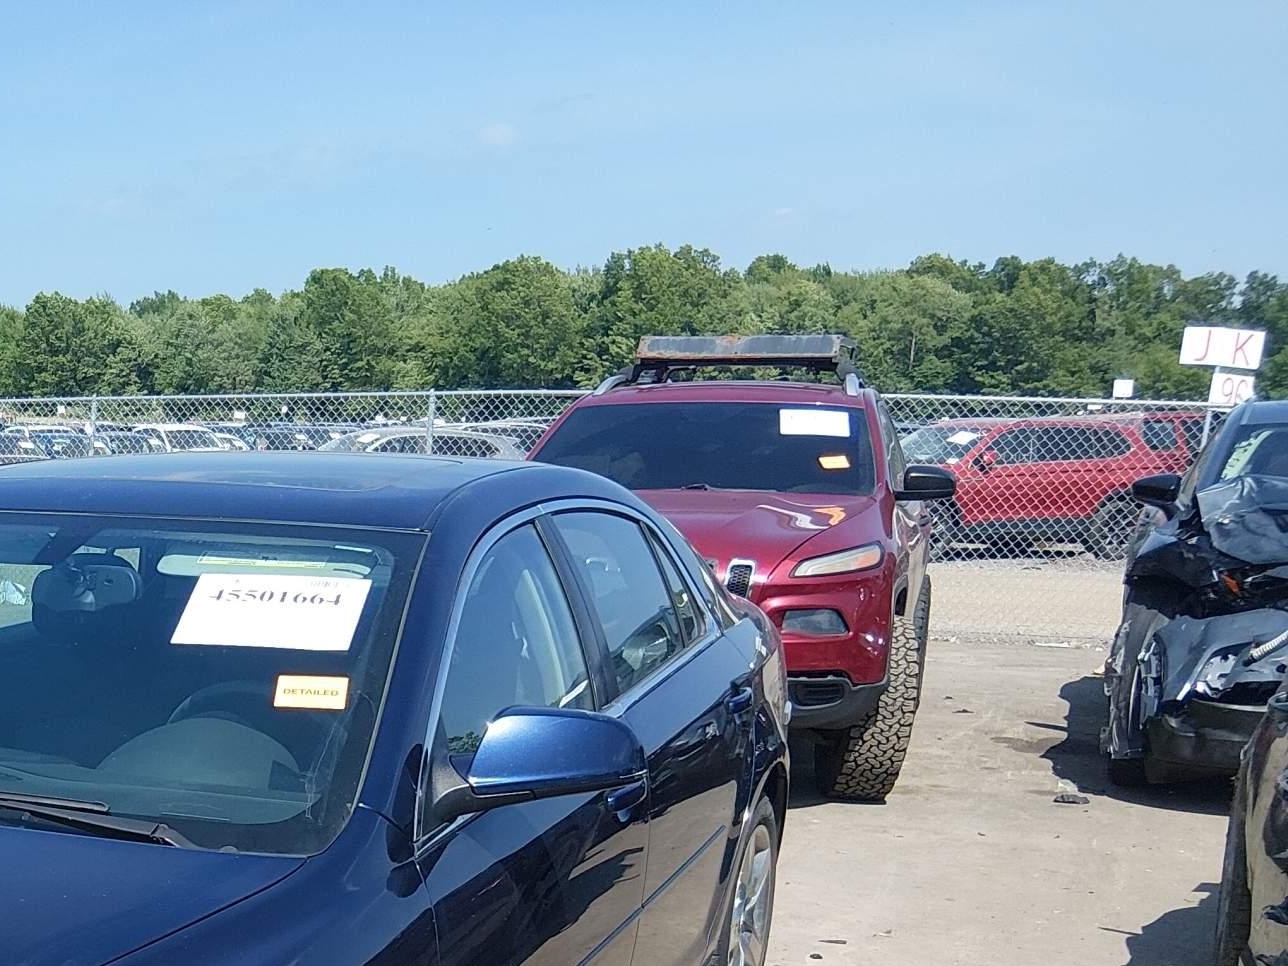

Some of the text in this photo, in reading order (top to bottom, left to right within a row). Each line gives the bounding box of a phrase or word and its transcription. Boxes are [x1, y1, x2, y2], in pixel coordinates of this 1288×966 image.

[1194, 329, 1255, 367] J K
[209, 588, 342, 606] 45501664
[283, 687, 340, 697] DETAILED
